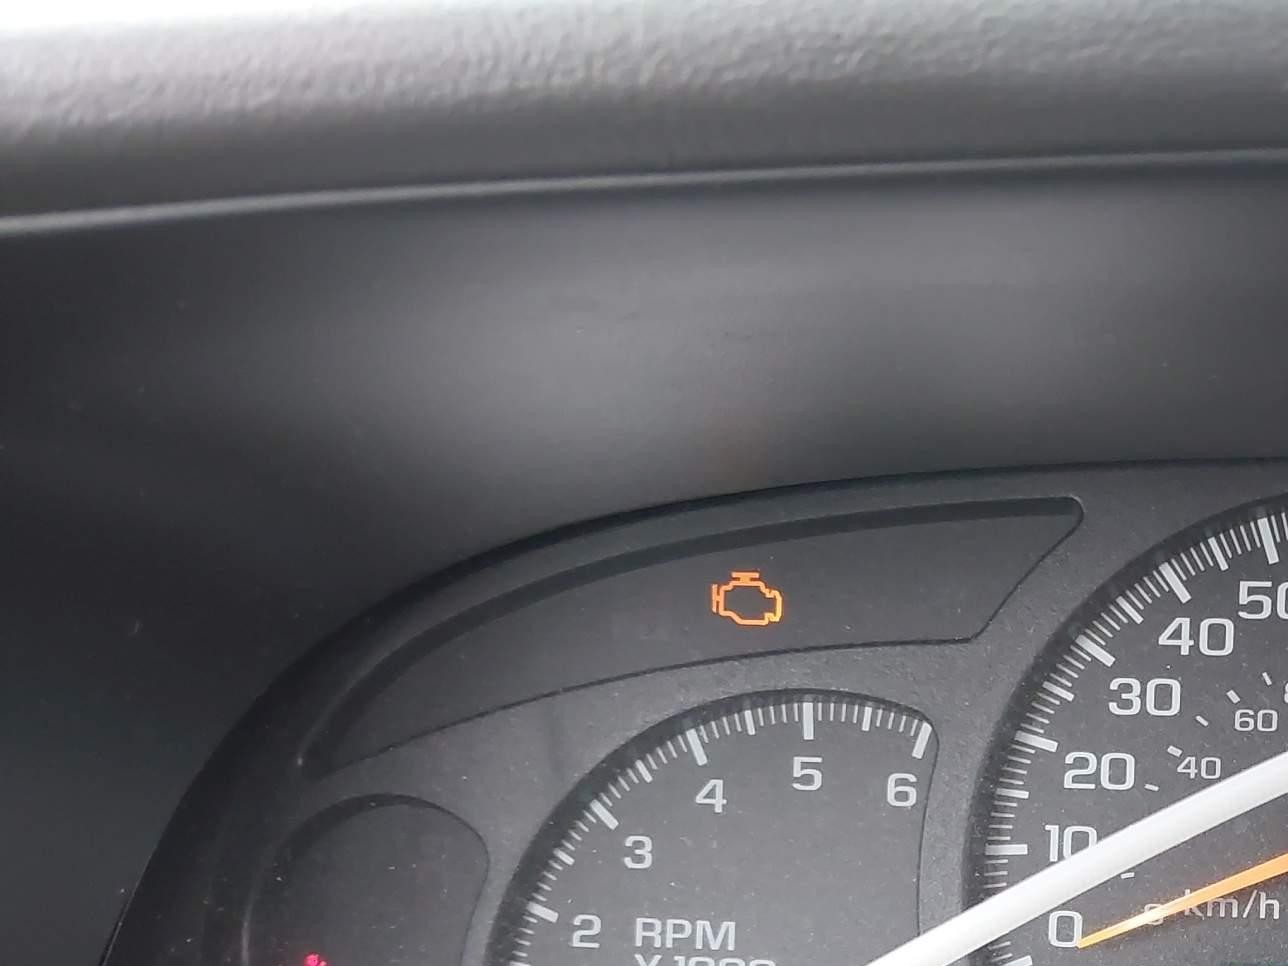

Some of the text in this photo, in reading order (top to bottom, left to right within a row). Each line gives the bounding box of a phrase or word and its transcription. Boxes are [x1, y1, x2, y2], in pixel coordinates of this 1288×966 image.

[1159, 617, 1234, 656] 40
[1108, 678, 1181, 716] 30
[1234, 709, 1278, 732] 60
[793, 756, 823, 791] 5
[1063, 751, 1135, 790] 20
[1177, 757, 1222, 780] 40
[695, 779, 727, 813] 4
[887, 773, 917, 807] 6
[624, 835, 653, 869] 3
[1045, 825, 1098, 862] 10
[1184, 888, 1280, 920] km/h
[571, 914, 600, 948] 2
[635, 917, 735, 951] RPM
[1048, 910, 1083, 948] 0
